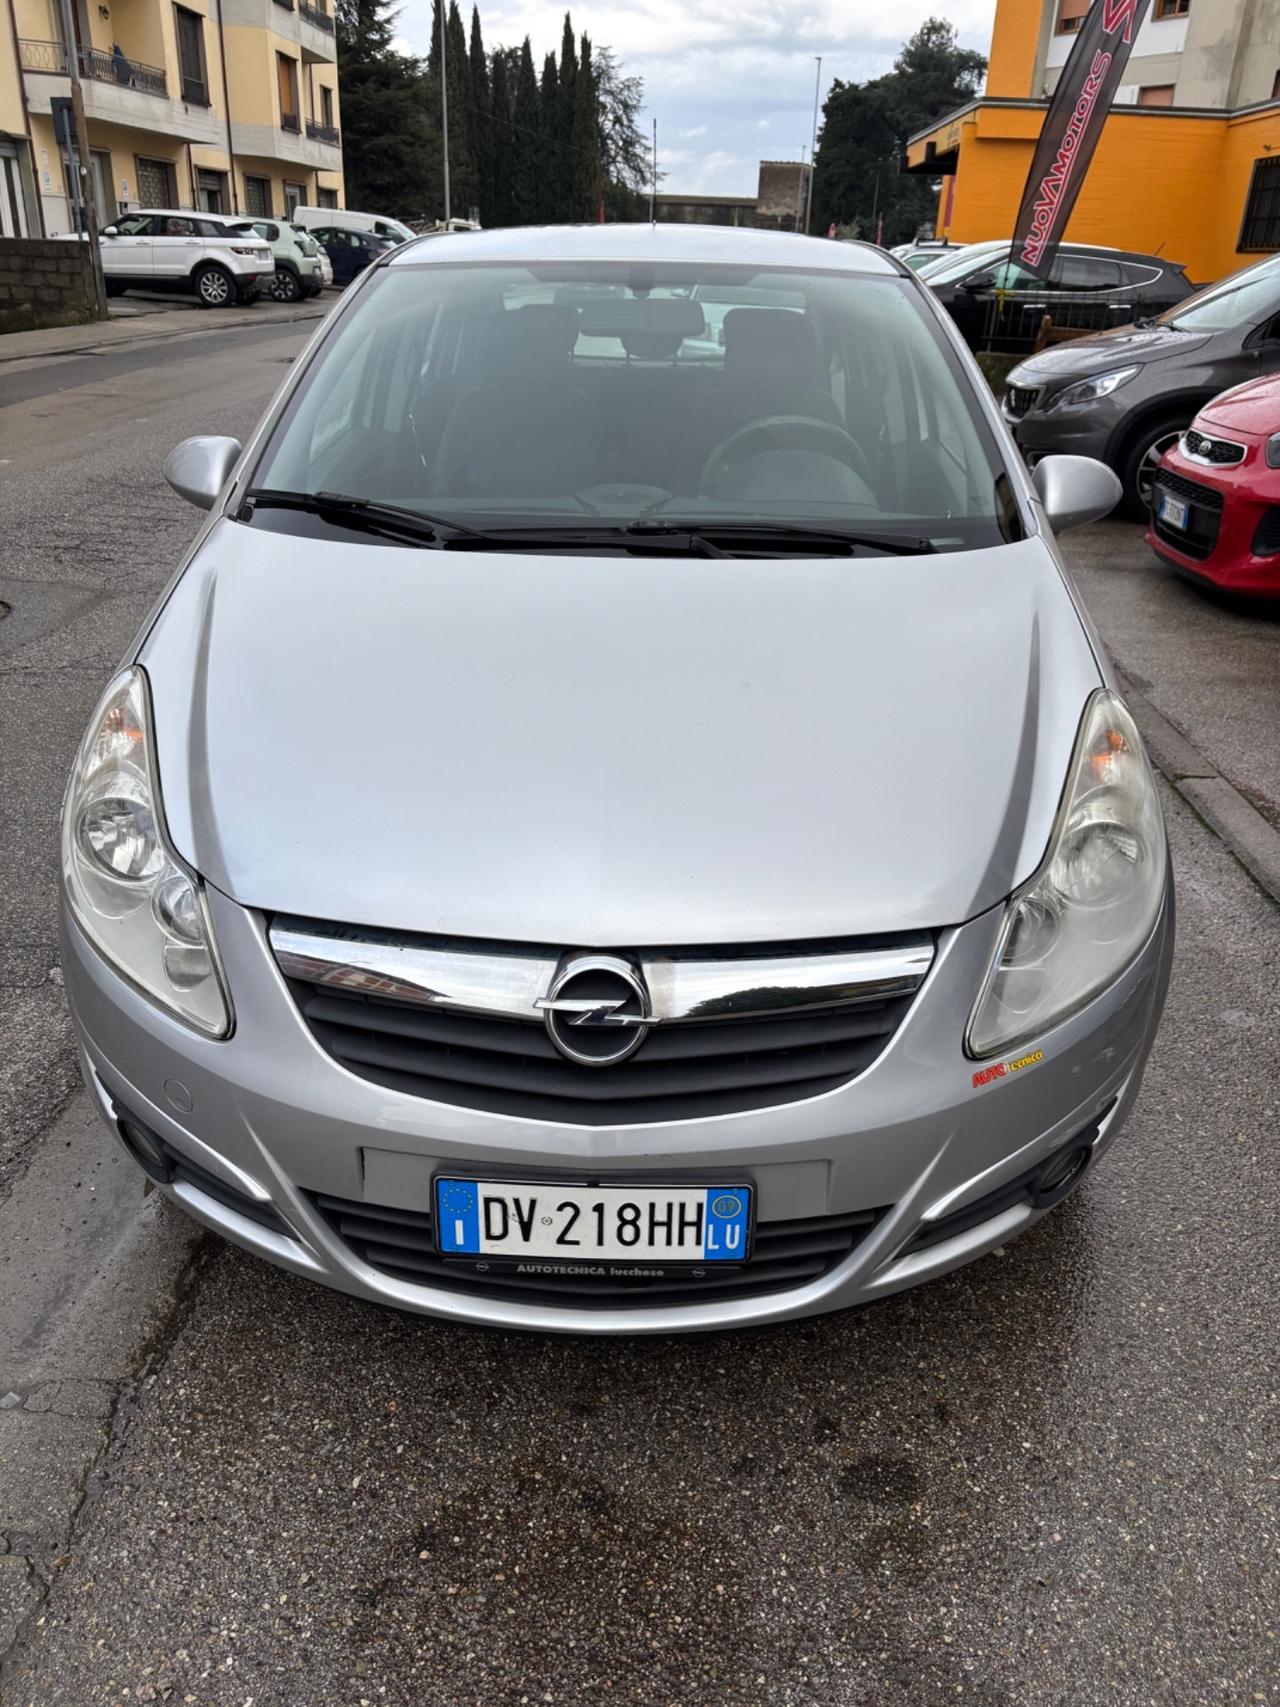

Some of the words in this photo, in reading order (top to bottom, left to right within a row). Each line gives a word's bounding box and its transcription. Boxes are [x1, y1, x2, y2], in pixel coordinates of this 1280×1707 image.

[455, 1220, 464, 1245] I
[483, 1197, 537, 1242] DV
[556, 1201, 704, 1246] 218HH
[707, 1224, 740, 1250] LU
[516, 1264, 606, 1276] AUTOTECNICA
